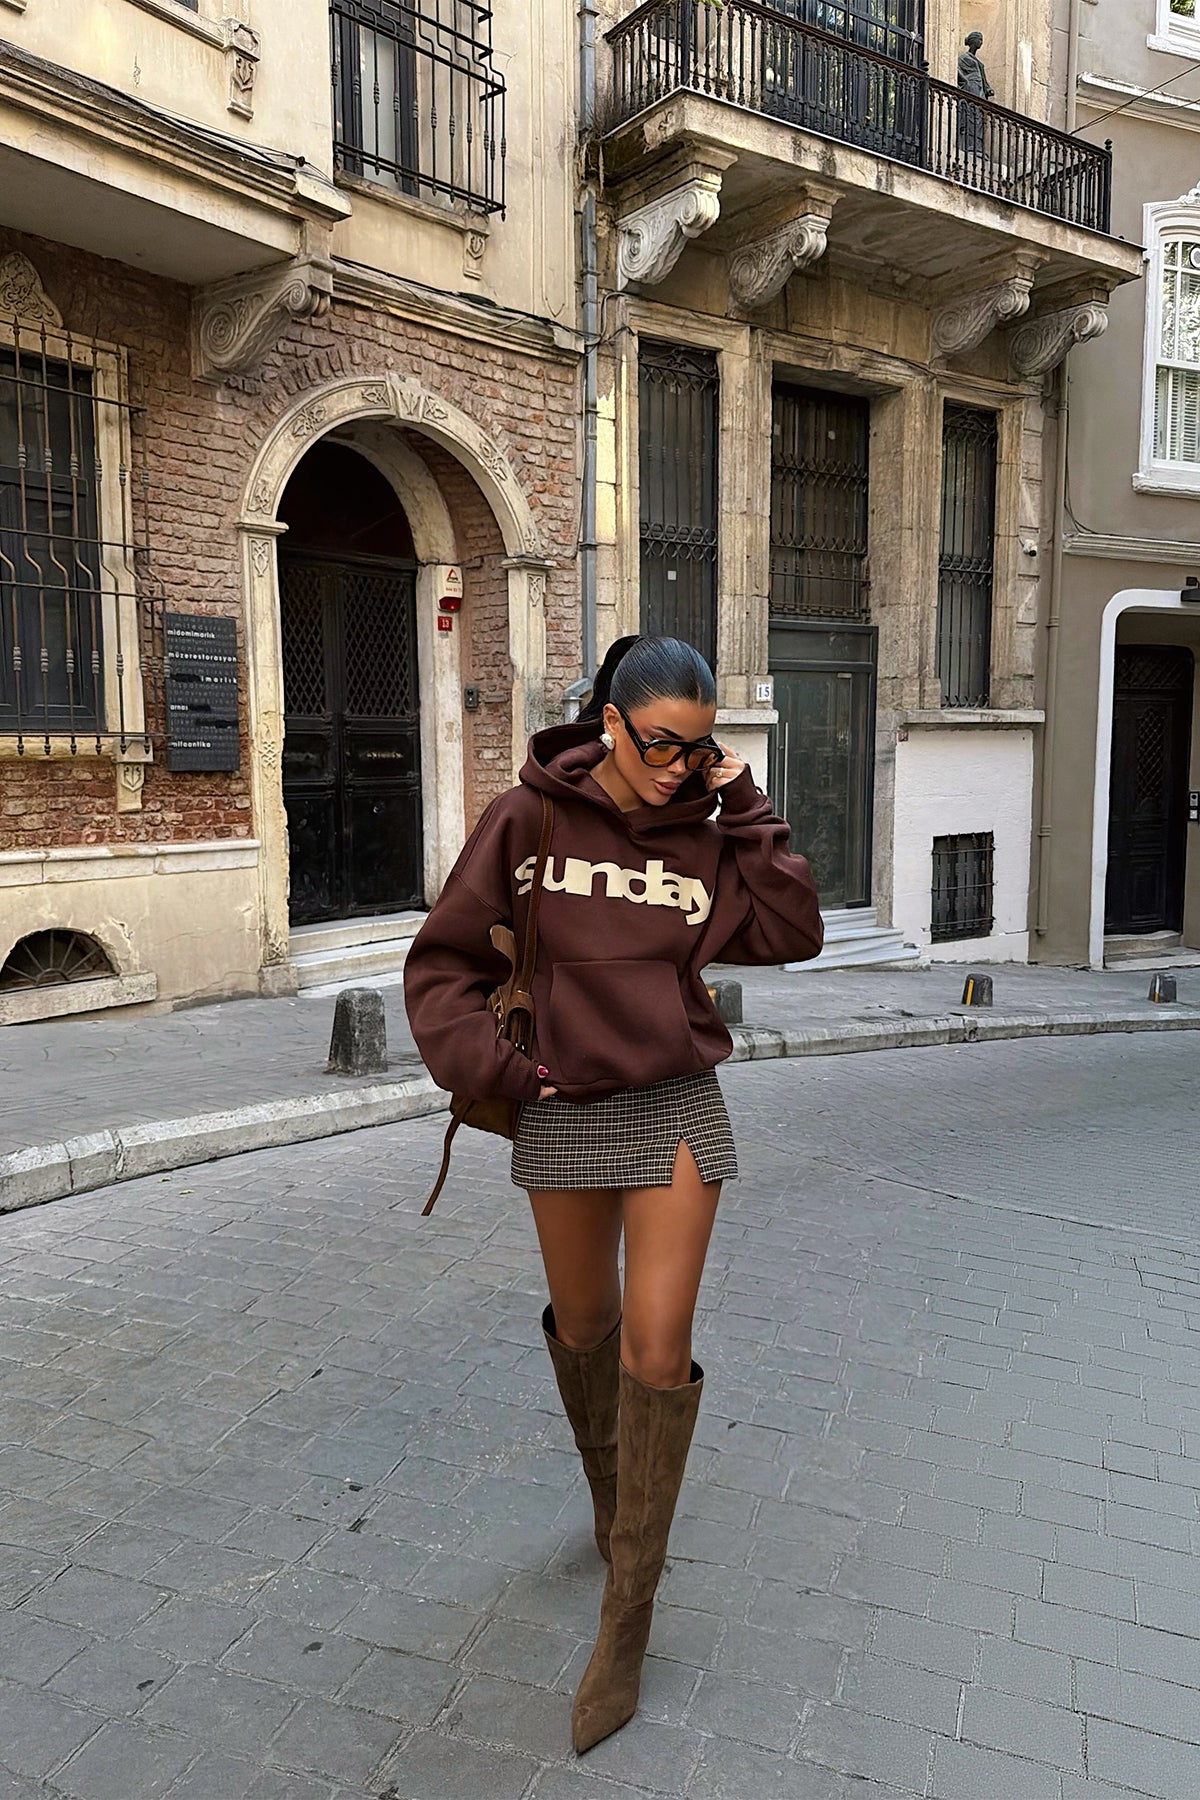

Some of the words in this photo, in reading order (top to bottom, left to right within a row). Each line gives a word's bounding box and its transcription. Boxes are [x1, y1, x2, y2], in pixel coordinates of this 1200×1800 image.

[442, 618, 450, 628] 13
[168, 651, 237, 663] müzerestorasyon
[758, 686, 770, 698] 15
[514, 856, 714, 926] sunday
